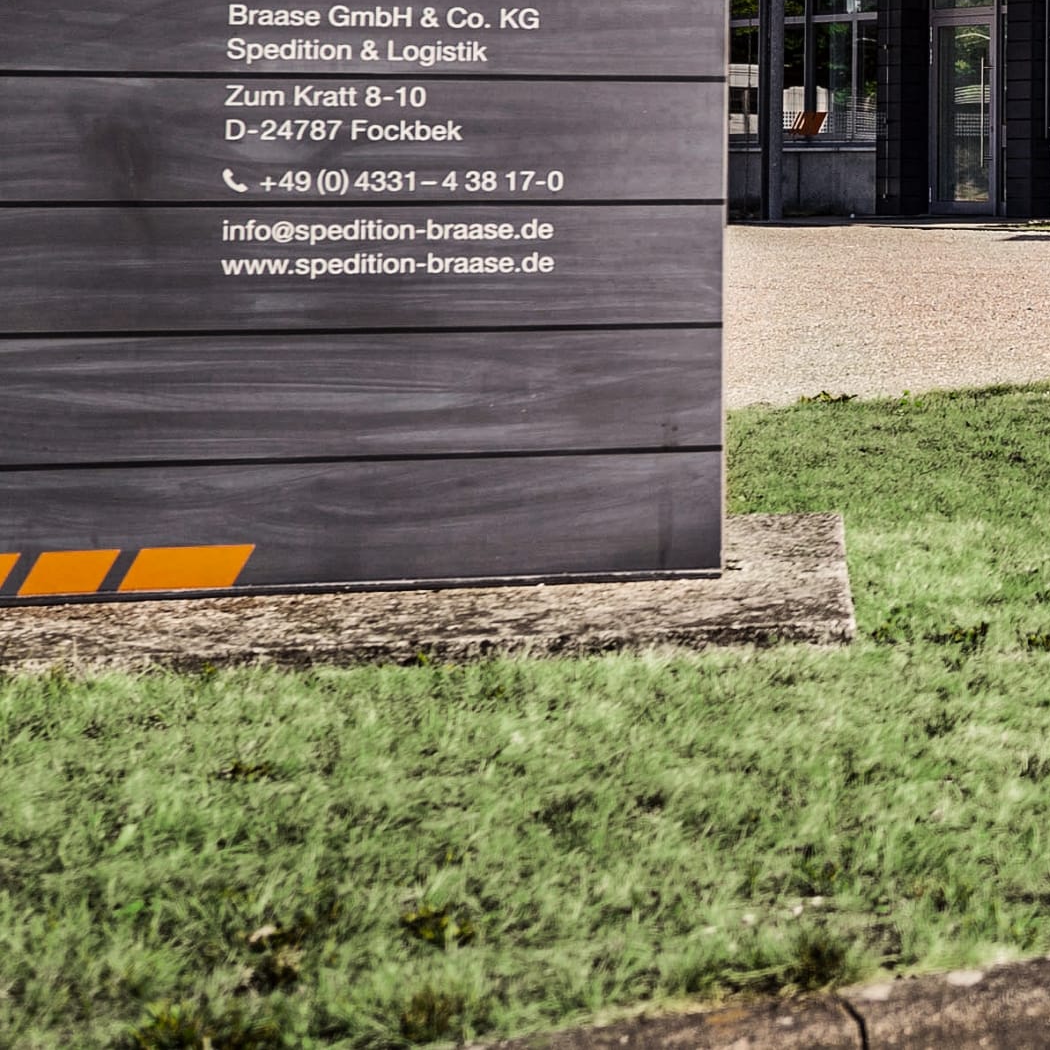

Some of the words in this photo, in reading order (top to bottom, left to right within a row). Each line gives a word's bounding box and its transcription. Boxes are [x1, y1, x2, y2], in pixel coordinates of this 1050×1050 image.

[229, 4, 321, 27] Braase
[328, 5, 413, 28] GmbH
[420, 6, 440, 29] &
[446, 6, 491, 29] Co.
[500, 8, 540, 30] KG
[226, 37, 353, 65] Spedition
[360, 39, 380, 61] &
[387, 39, 488, 67] Logistik
[224, 84, 285, 107] Zum
[294, 85, 358, 107] Kratt
[364, 85, 427, 108] 8-10
[225, 119, 343, 141] D-24787
[351, 119, 463, 141] Fockbek
[259, 169, 312, 192] +49
[317, 169, 349, 196] (0)
[464, 170, 498, 192] 38
[505, 170, 564, 192] 17-0
[222, 218, 554, 246] info@spedition-braase.de
[221, 251, 555, 280] www.spedition-braase.de
